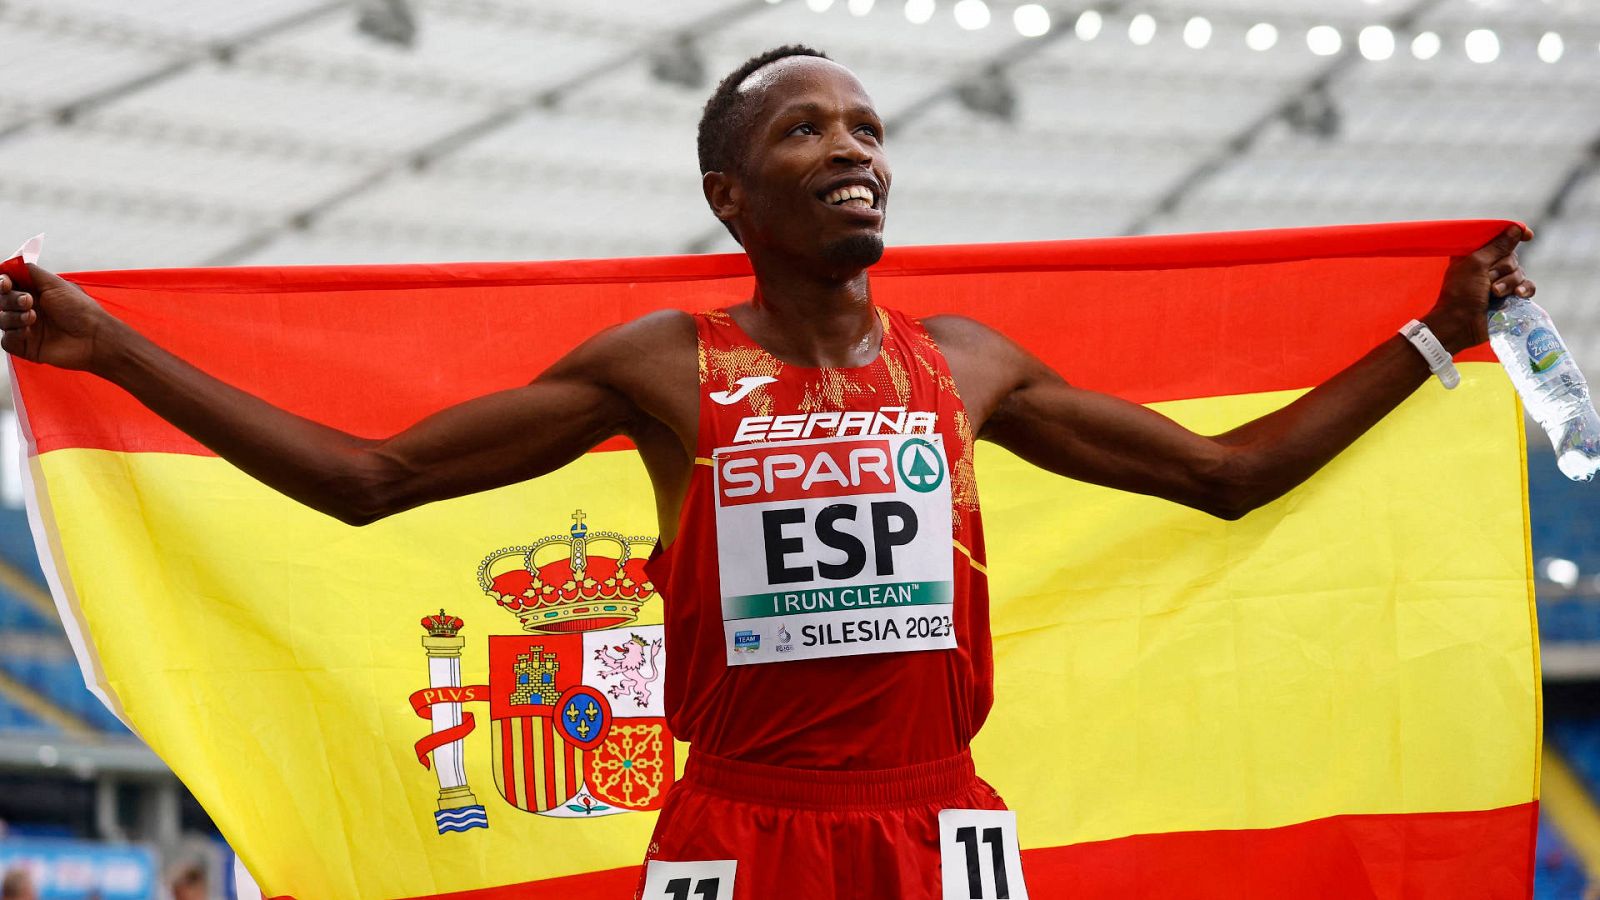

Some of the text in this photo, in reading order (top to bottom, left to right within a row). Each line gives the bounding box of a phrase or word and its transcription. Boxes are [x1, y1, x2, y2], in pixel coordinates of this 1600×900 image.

[733, 406, 937, 443] ESPAÑA
[722, 448, 891, 498] SPAR
[762, 501, 919, 585] ESP
[773, 595, 779, 612] I
[785, 590, 835, 612] RUN
[802, 616, 950, 647] SILESIA 2023
[423, 688, 475, 704] PLVS
[956, 826, 1010, 899] 11
